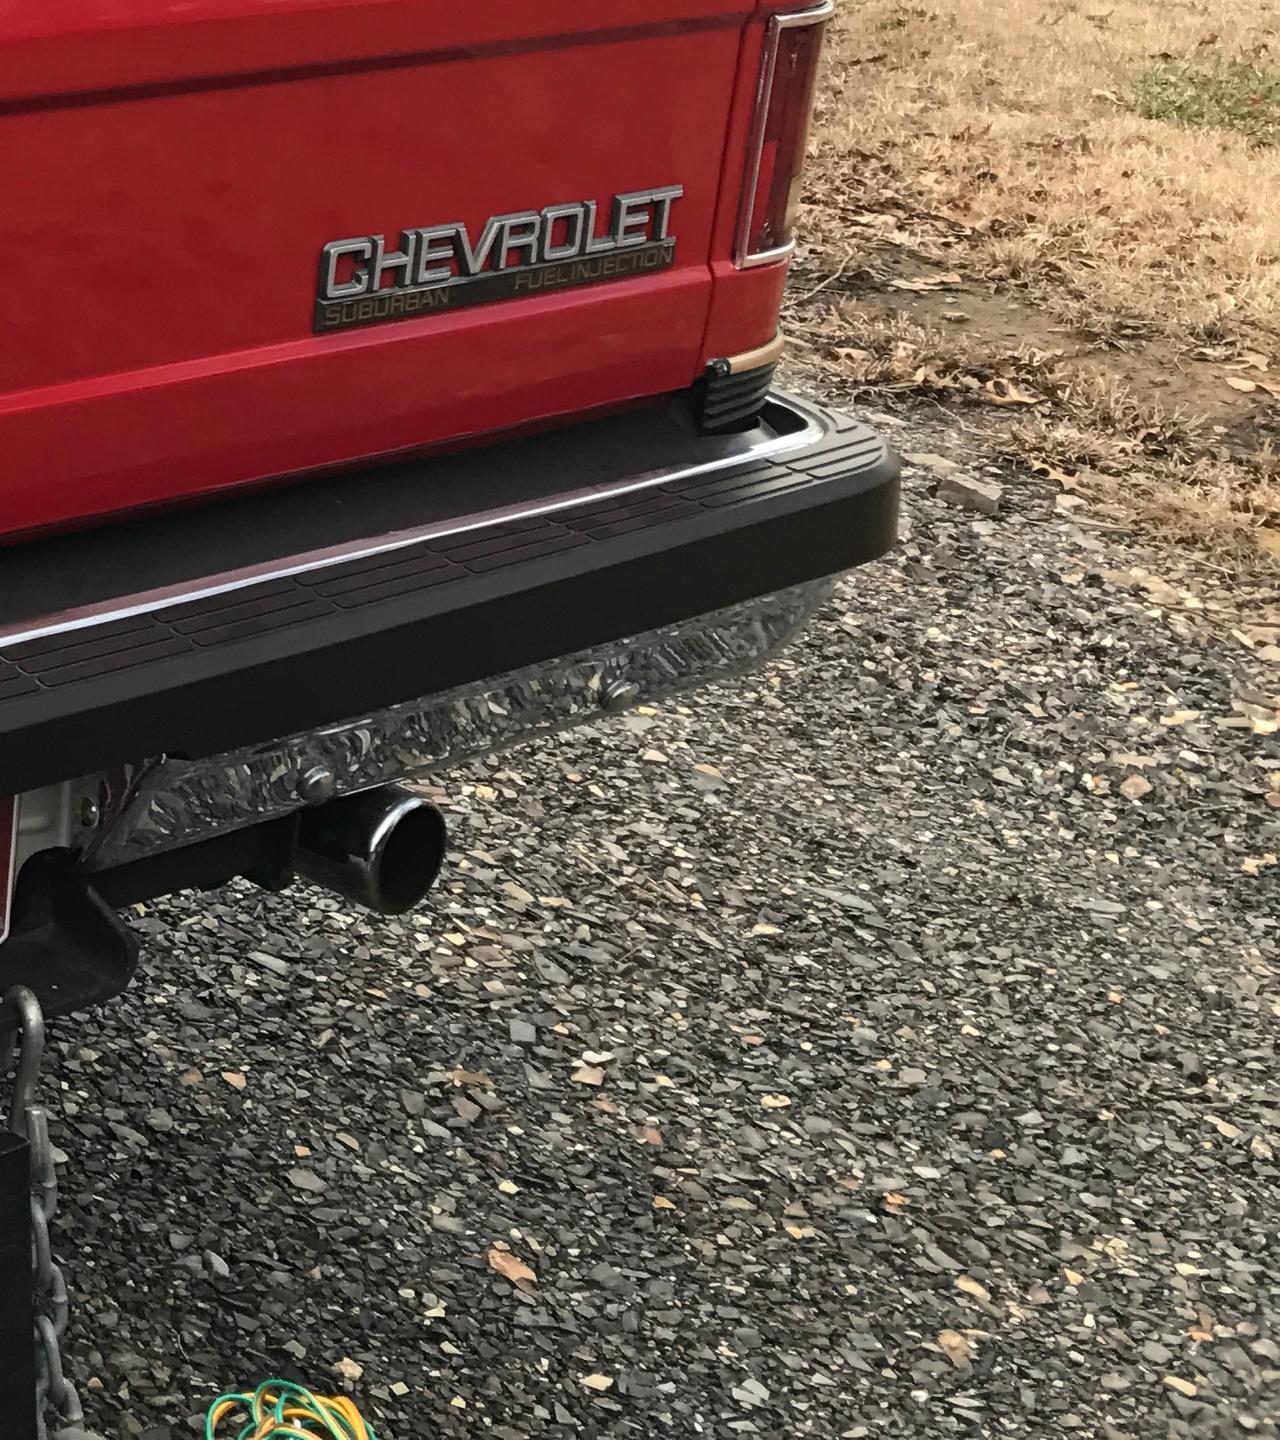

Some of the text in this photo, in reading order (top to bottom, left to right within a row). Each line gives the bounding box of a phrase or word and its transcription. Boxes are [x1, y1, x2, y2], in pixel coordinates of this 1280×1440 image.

[321, 185, 683, 299] CHEVROLET
[514, 247, 673, 291] FUEL INJECTION
[324, 290, 449, 326] SUBURBAN
